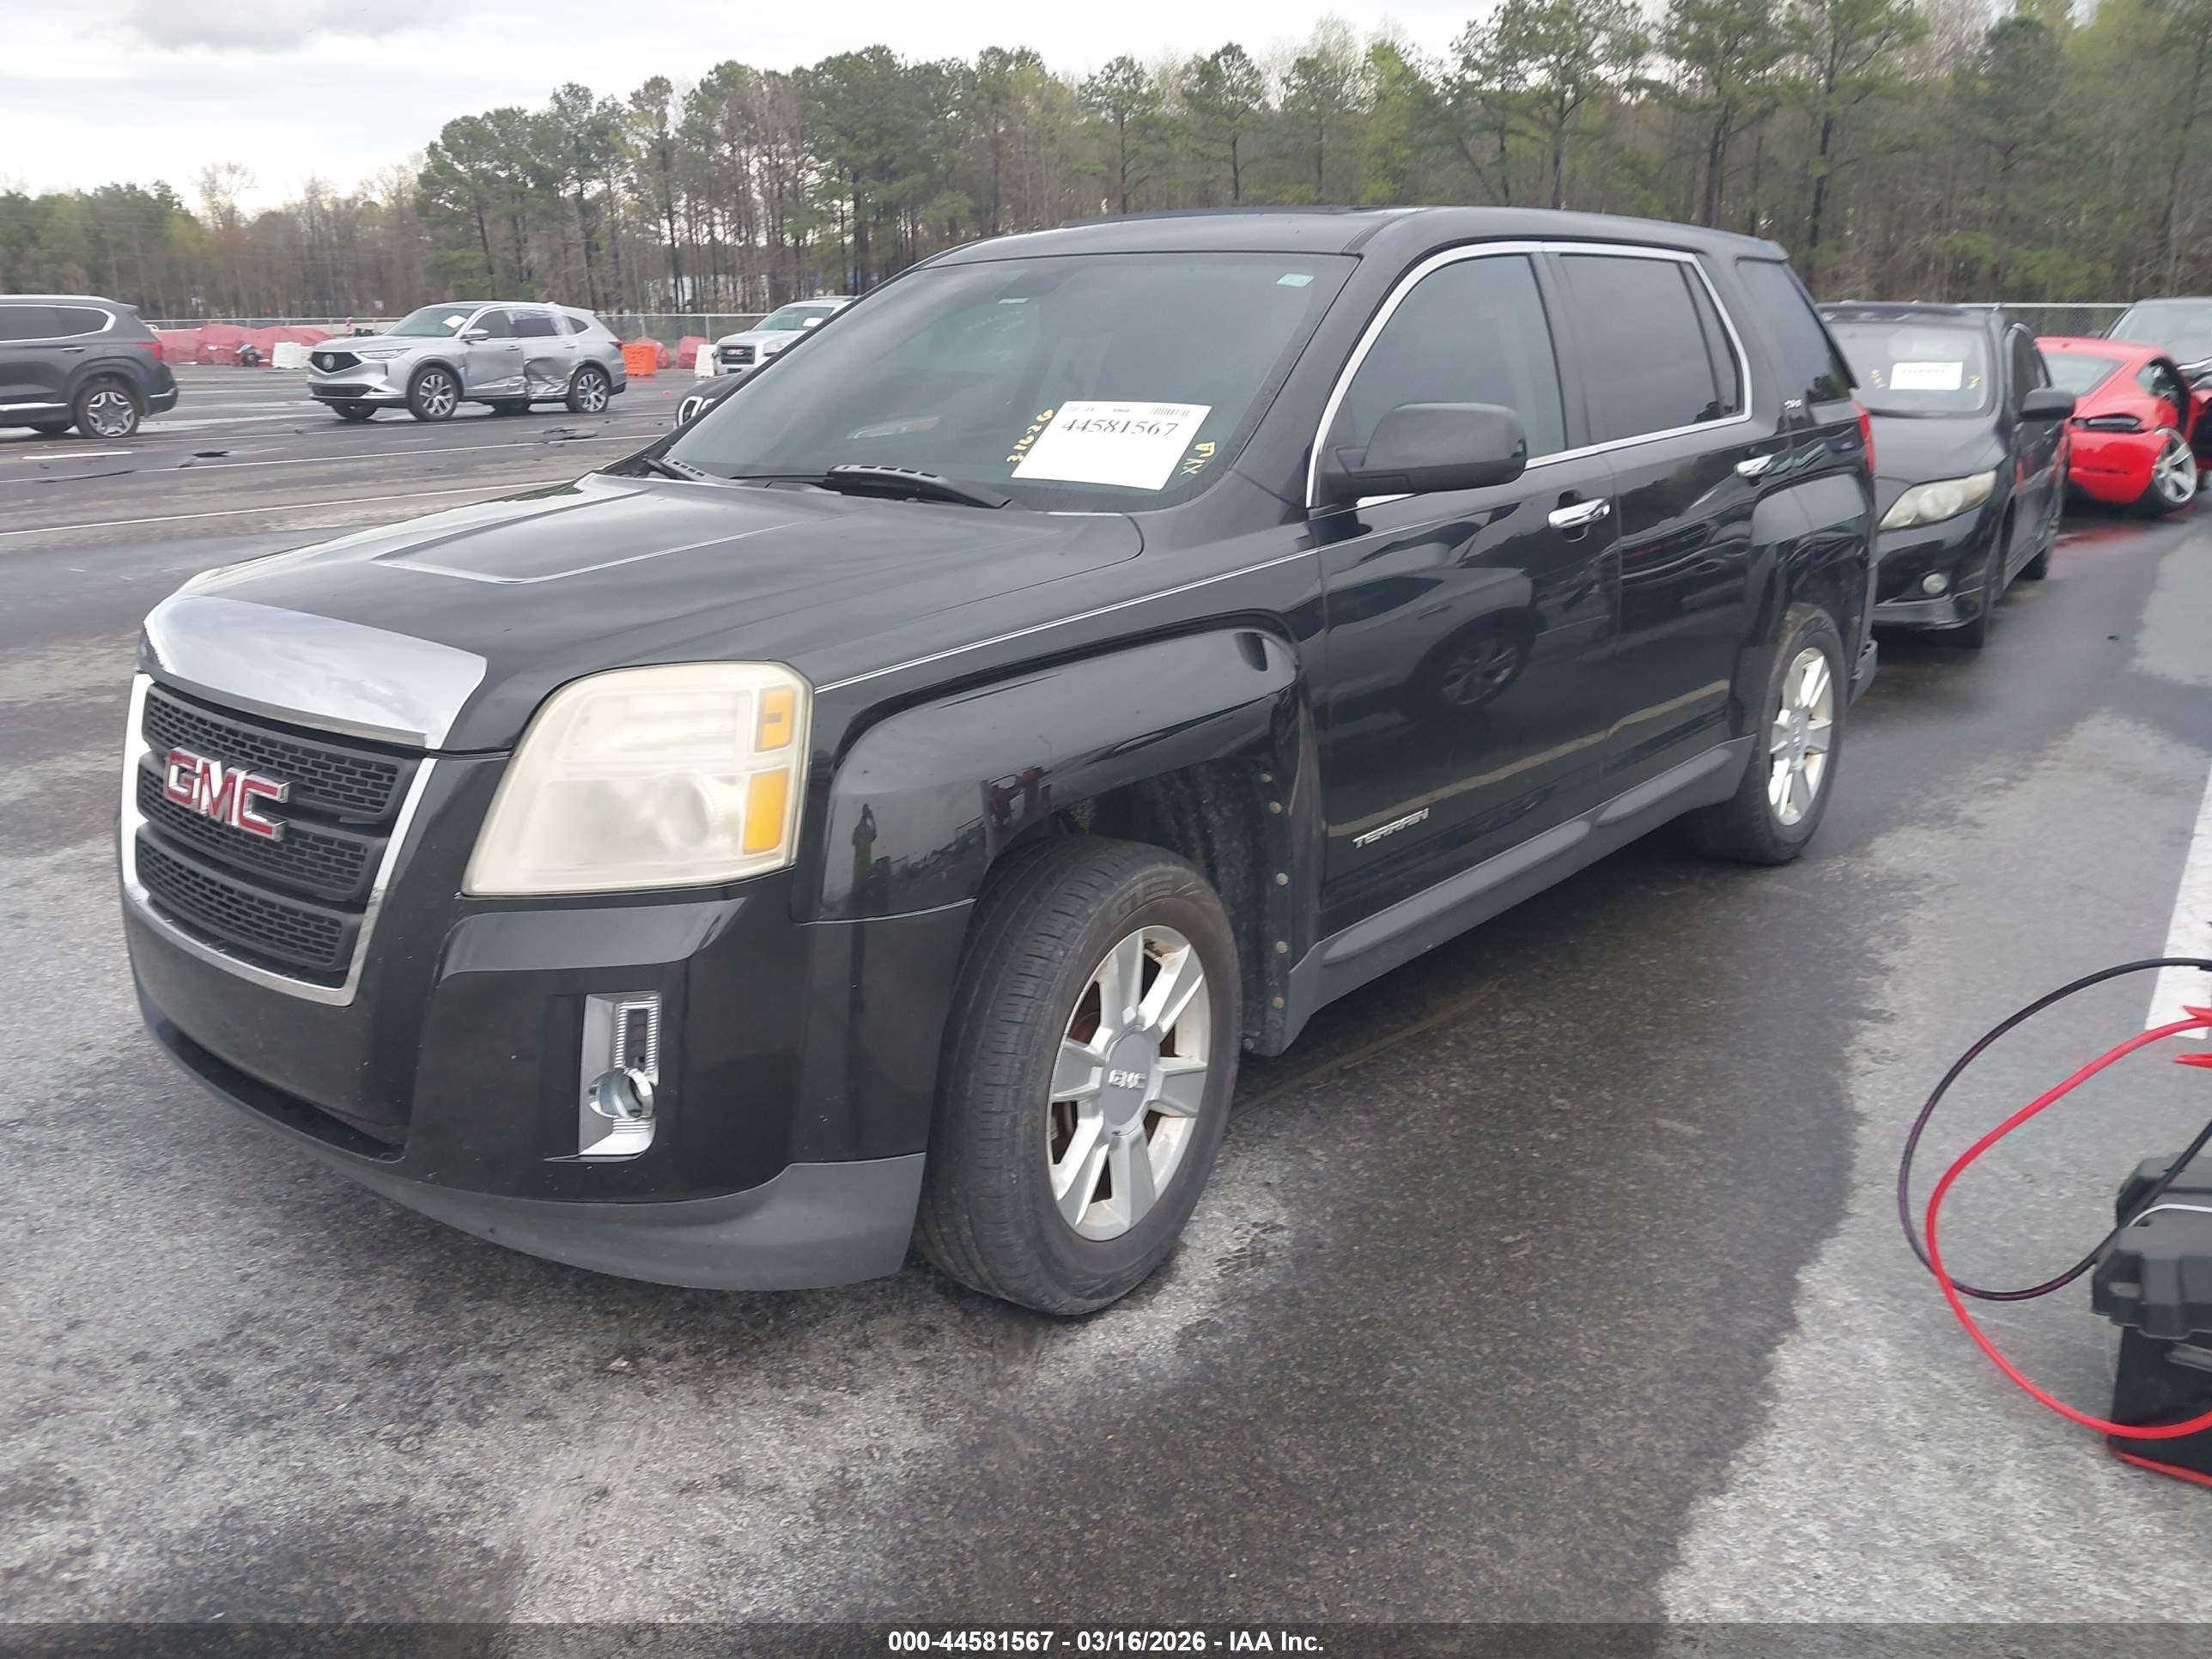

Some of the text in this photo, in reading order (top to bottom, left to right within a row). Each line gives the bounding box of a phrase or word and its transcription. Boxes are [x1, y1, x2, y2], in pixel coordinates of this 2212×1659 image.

[1061, 418, 1180, 437] 44581567
[163, 746, 289, 842] GMC
[1109, 1069, 1147, 1089] GMC
